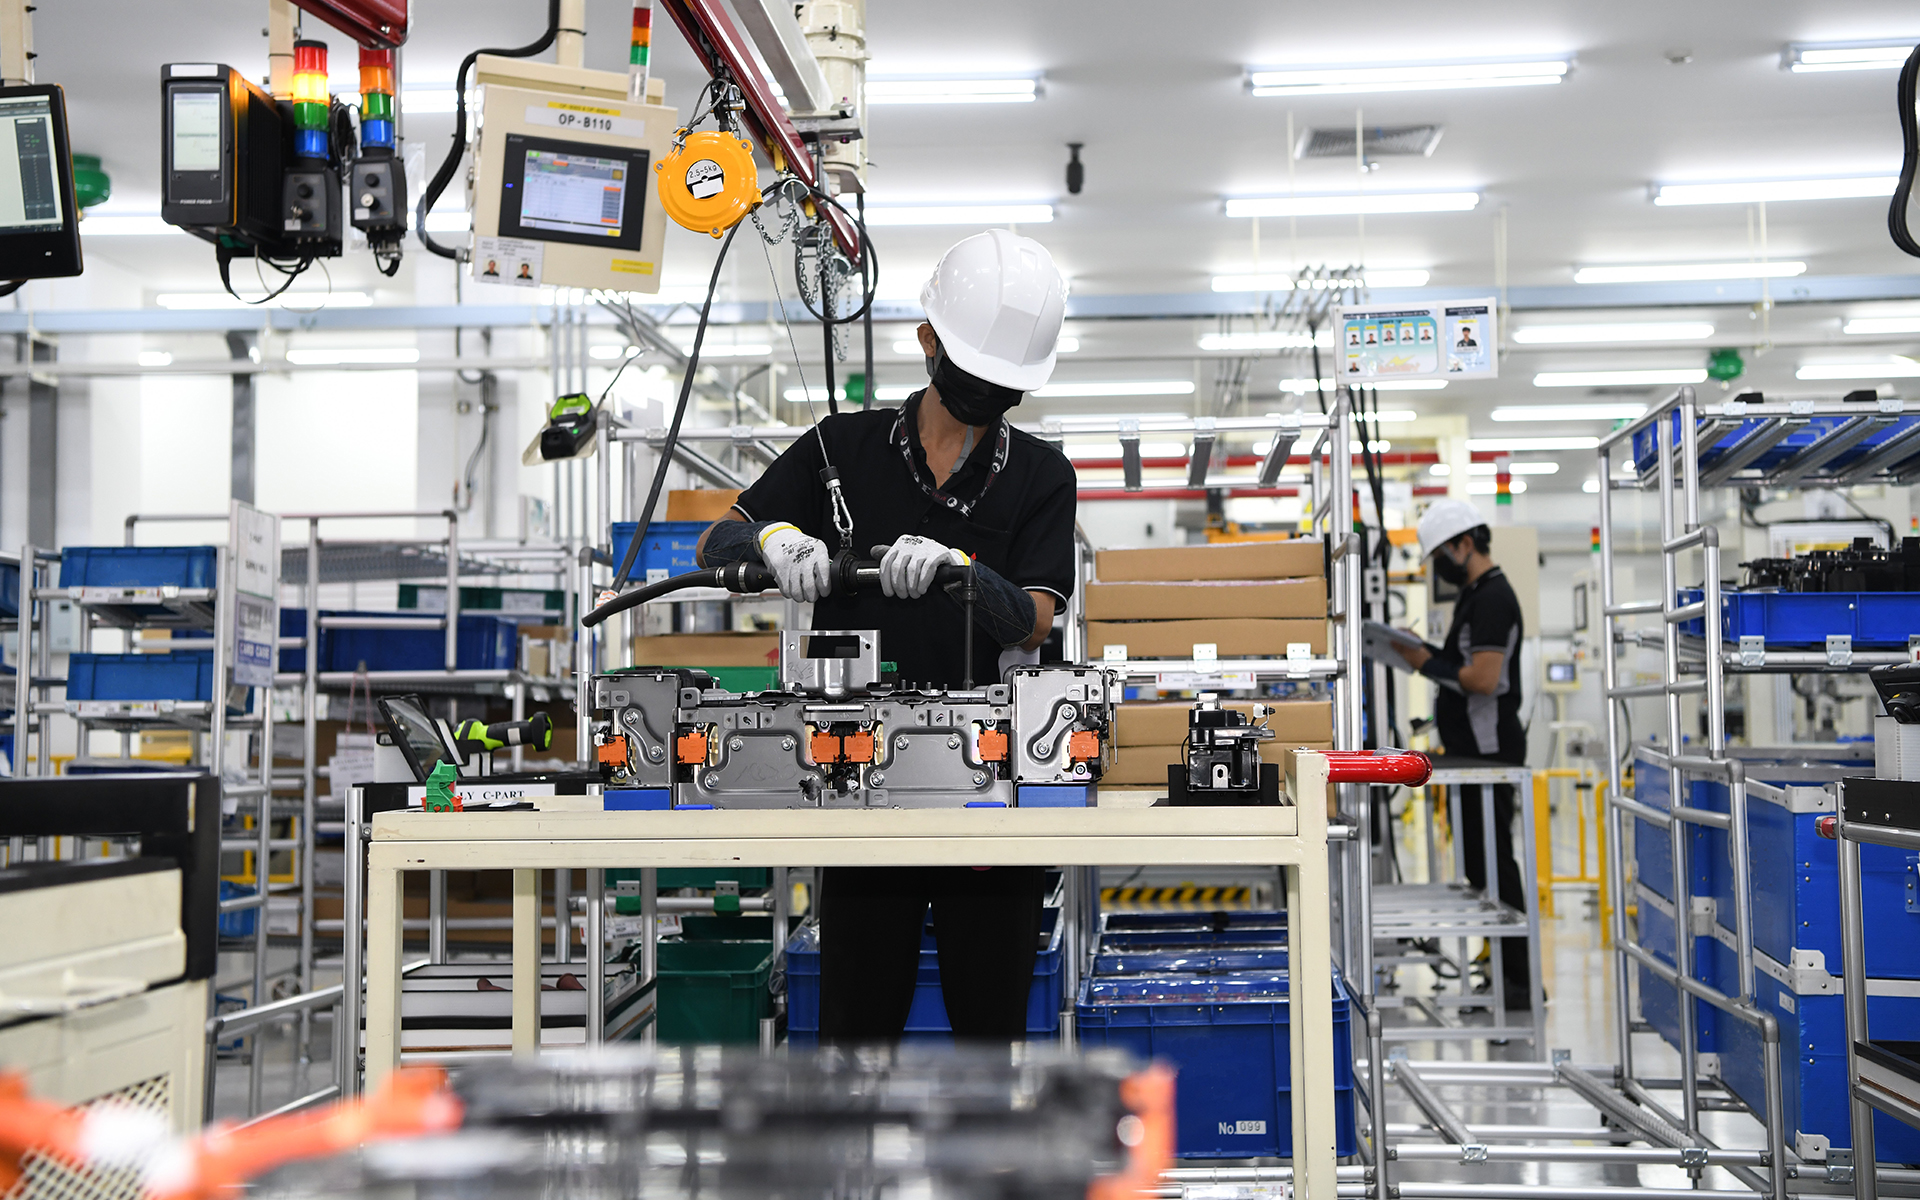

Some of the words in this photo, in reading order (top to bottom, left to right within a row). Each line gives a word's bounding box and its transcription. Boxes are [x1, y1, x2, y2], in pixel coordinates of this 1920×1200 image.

[558, 113, 612, 131] OP-B110
[688, 164, 717, 179] 2.5-5kg
[482, 790, 525, 800] C-PART
[1239, 1121, 1261, 1132] 099
